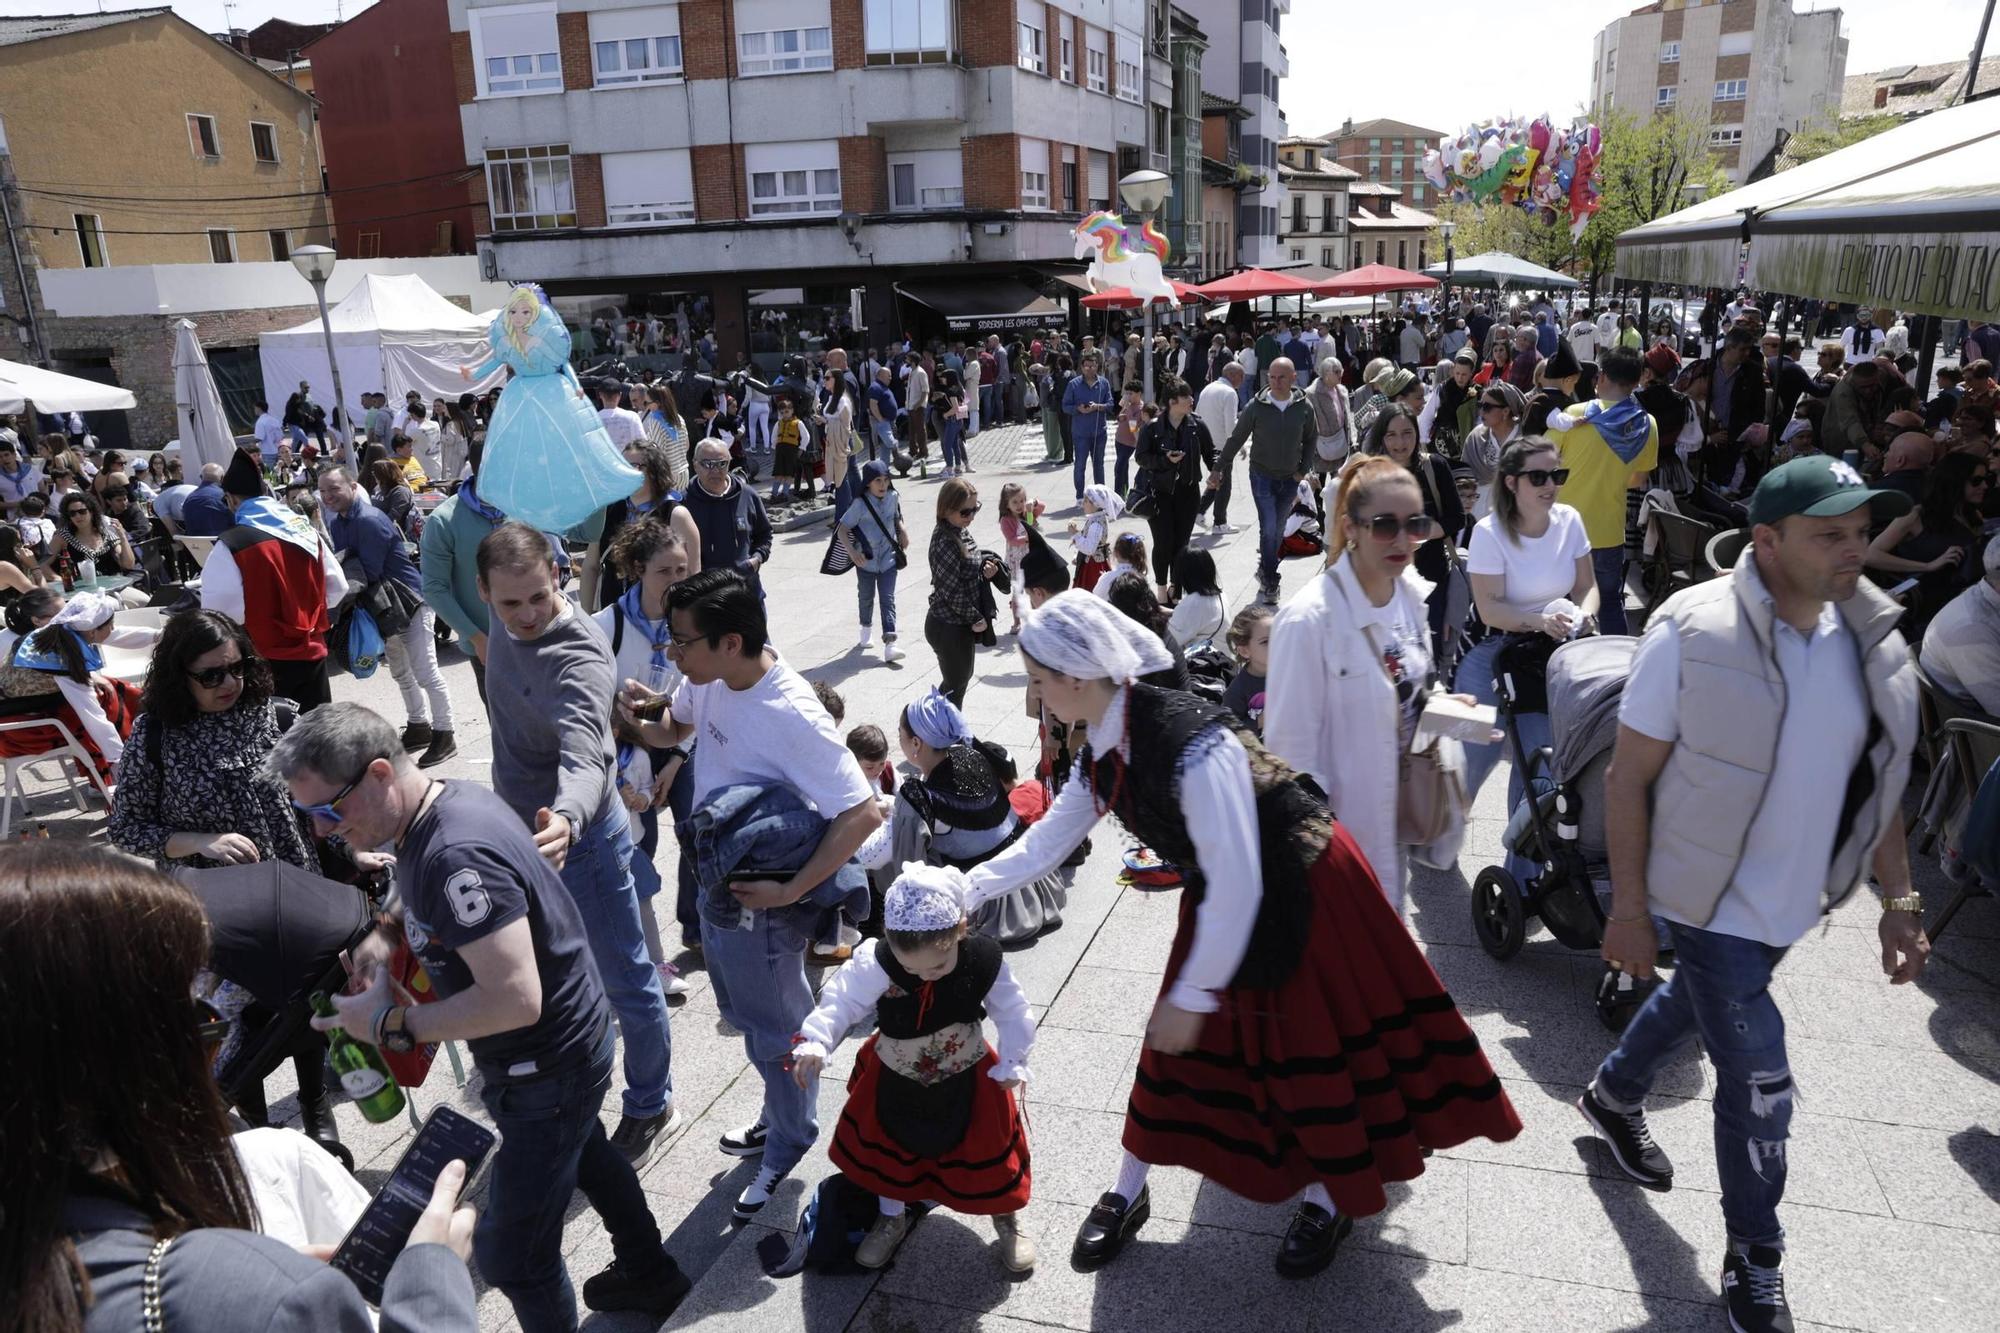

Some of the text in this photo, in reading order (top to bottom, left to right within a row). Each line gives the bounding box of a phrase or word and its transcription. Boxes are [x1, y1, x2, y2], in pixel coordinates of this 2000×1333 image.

[1836, 244, 2000, 313] EL PATIO DE BUTAC
[1005, 319, 1015, 328] LES
[444, 868, 492, 927] 6
